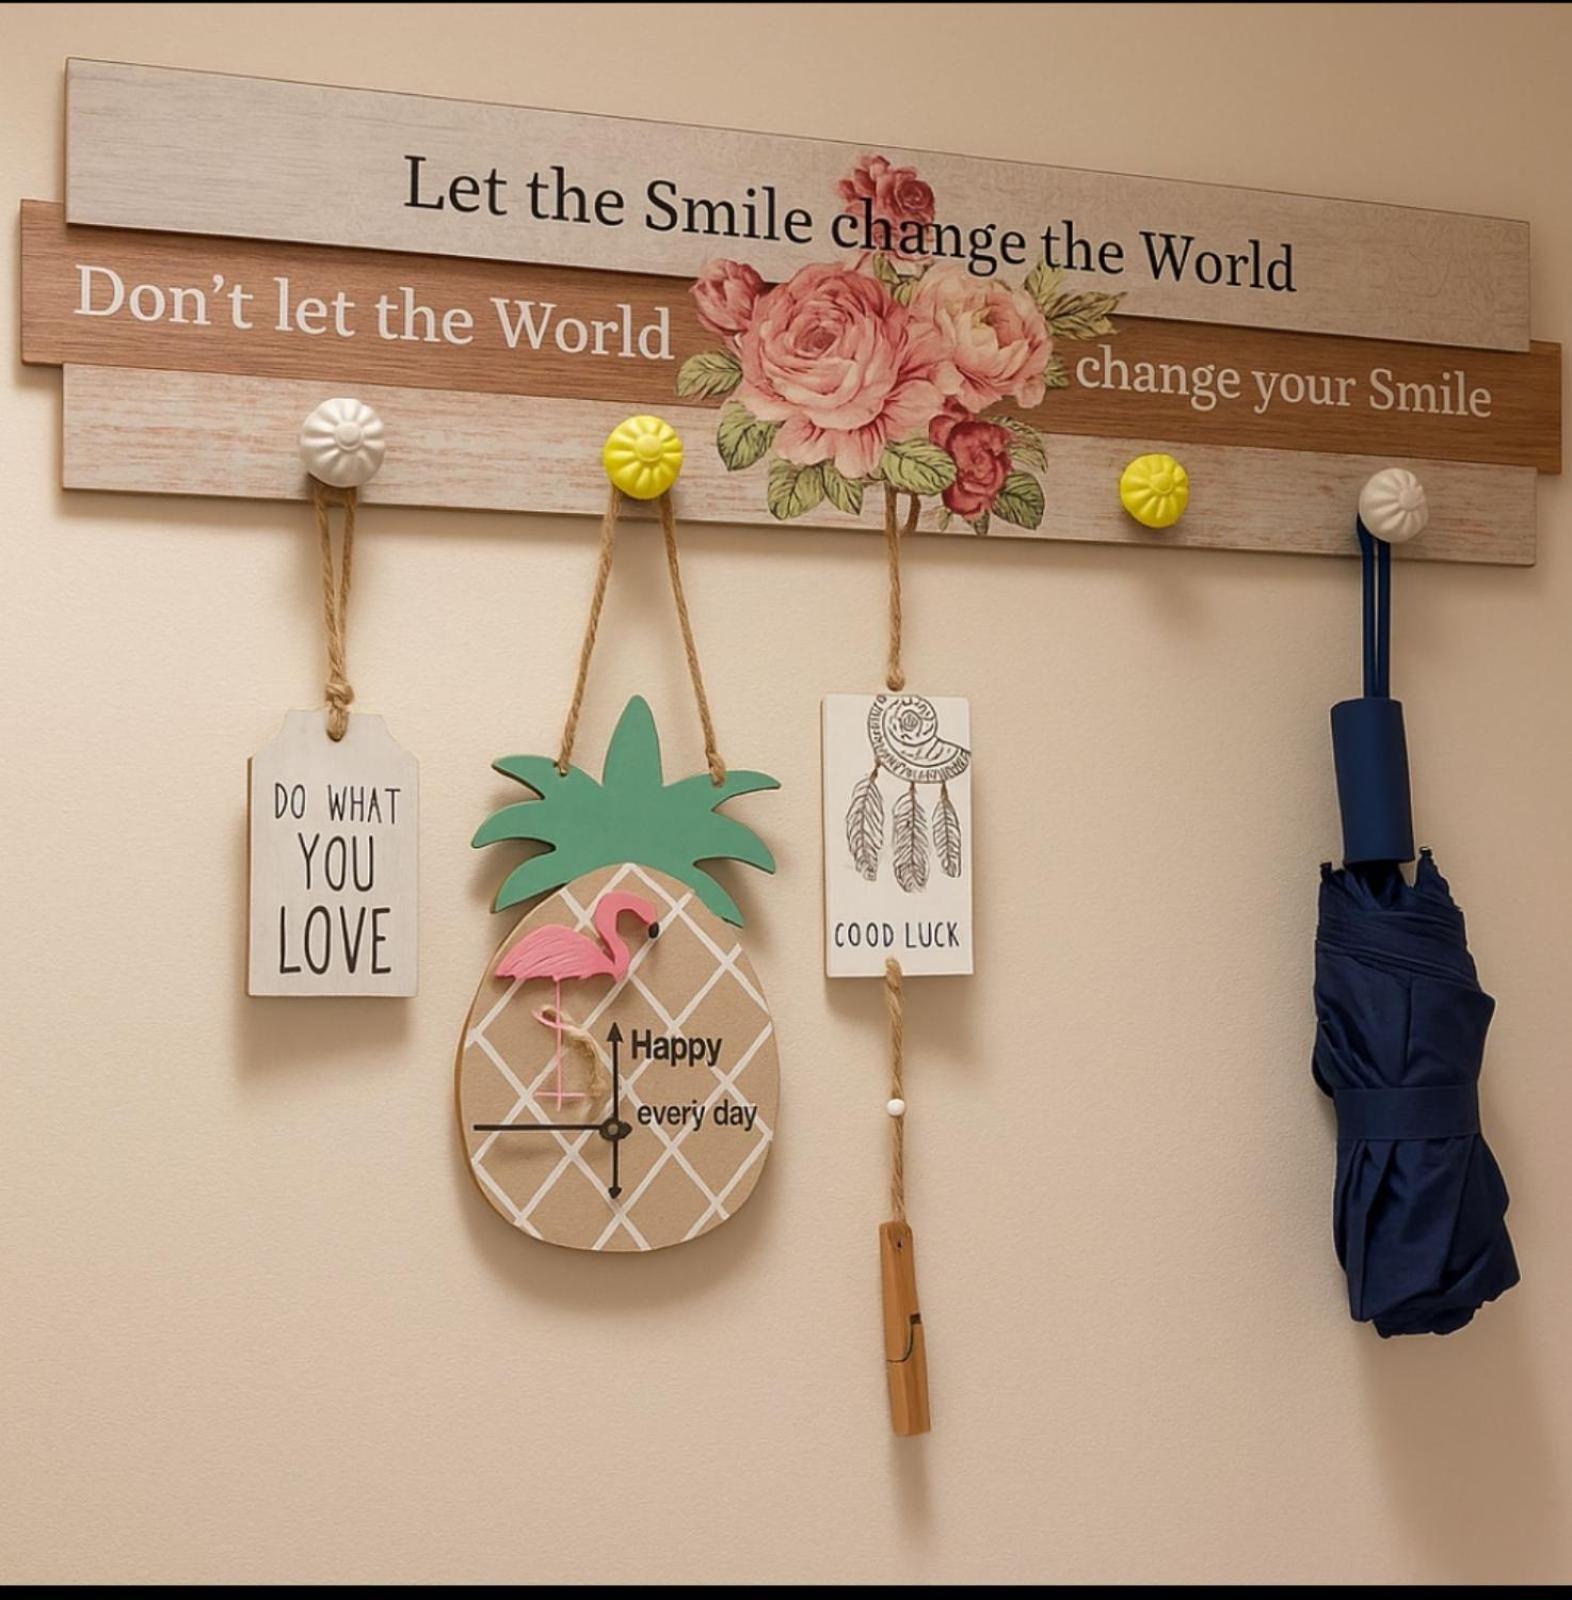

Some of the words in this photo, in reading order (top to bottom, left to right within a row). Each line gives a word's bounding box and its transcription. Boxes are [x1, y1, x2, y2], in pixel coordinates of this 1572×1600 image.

[404, 154, 508, 217] Let
[525, 165, 625, 226] the
[644, 179, 815, 243] Smile
[830, 197, 1028, 277] change
[1040, 220, 1125, 275] the
[1138, 230, 1297, 293] World
[274, 276, 356, 337] let
[375, 287, 475, 345] the
[489, 297, 676, 361] World
[1075, 344, 1242, 412] change
[1253, 366, 1358, 414] your
[1369, 367, 1493, 419] Smile
[275, 782, 306, 820] DO
[327, 784, 401, 825] WHAT
[298, 832, 374, 892] YOU
[279, 905, 392, 975] LOVE
[905, 921, 960, 949] LUCK
[631, 1028, 723, 1068] Happy
[713, 1098, 758, 1132] day
